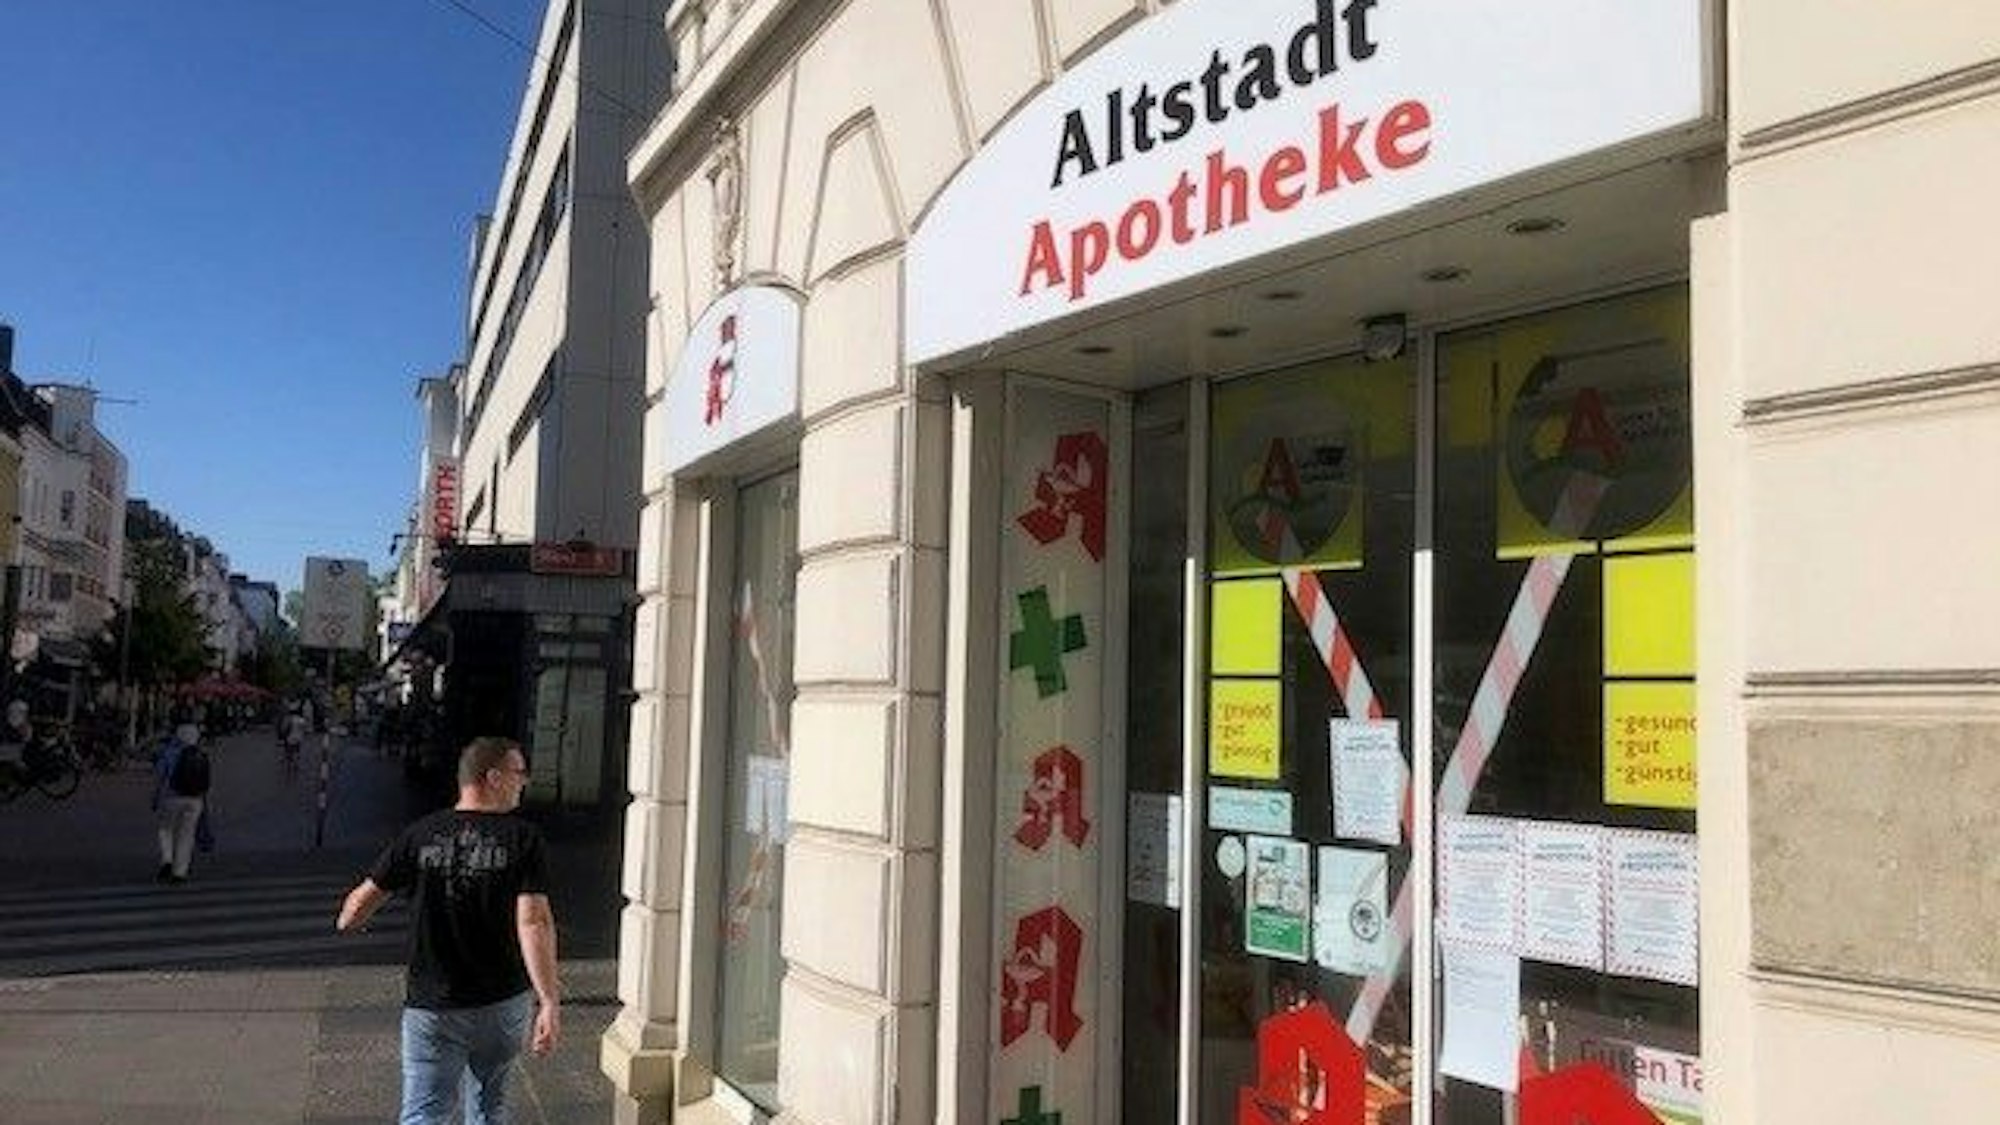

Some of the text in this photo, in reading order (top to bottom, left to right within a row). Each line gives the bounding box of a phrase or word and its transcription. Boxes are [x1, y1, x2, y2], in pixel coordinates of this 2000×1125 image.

[1051, 0, 1379, 188] Altstadt
[1019, 99, 1432, 302] Apotheke
[1624, 740, 1660, 758] gut
